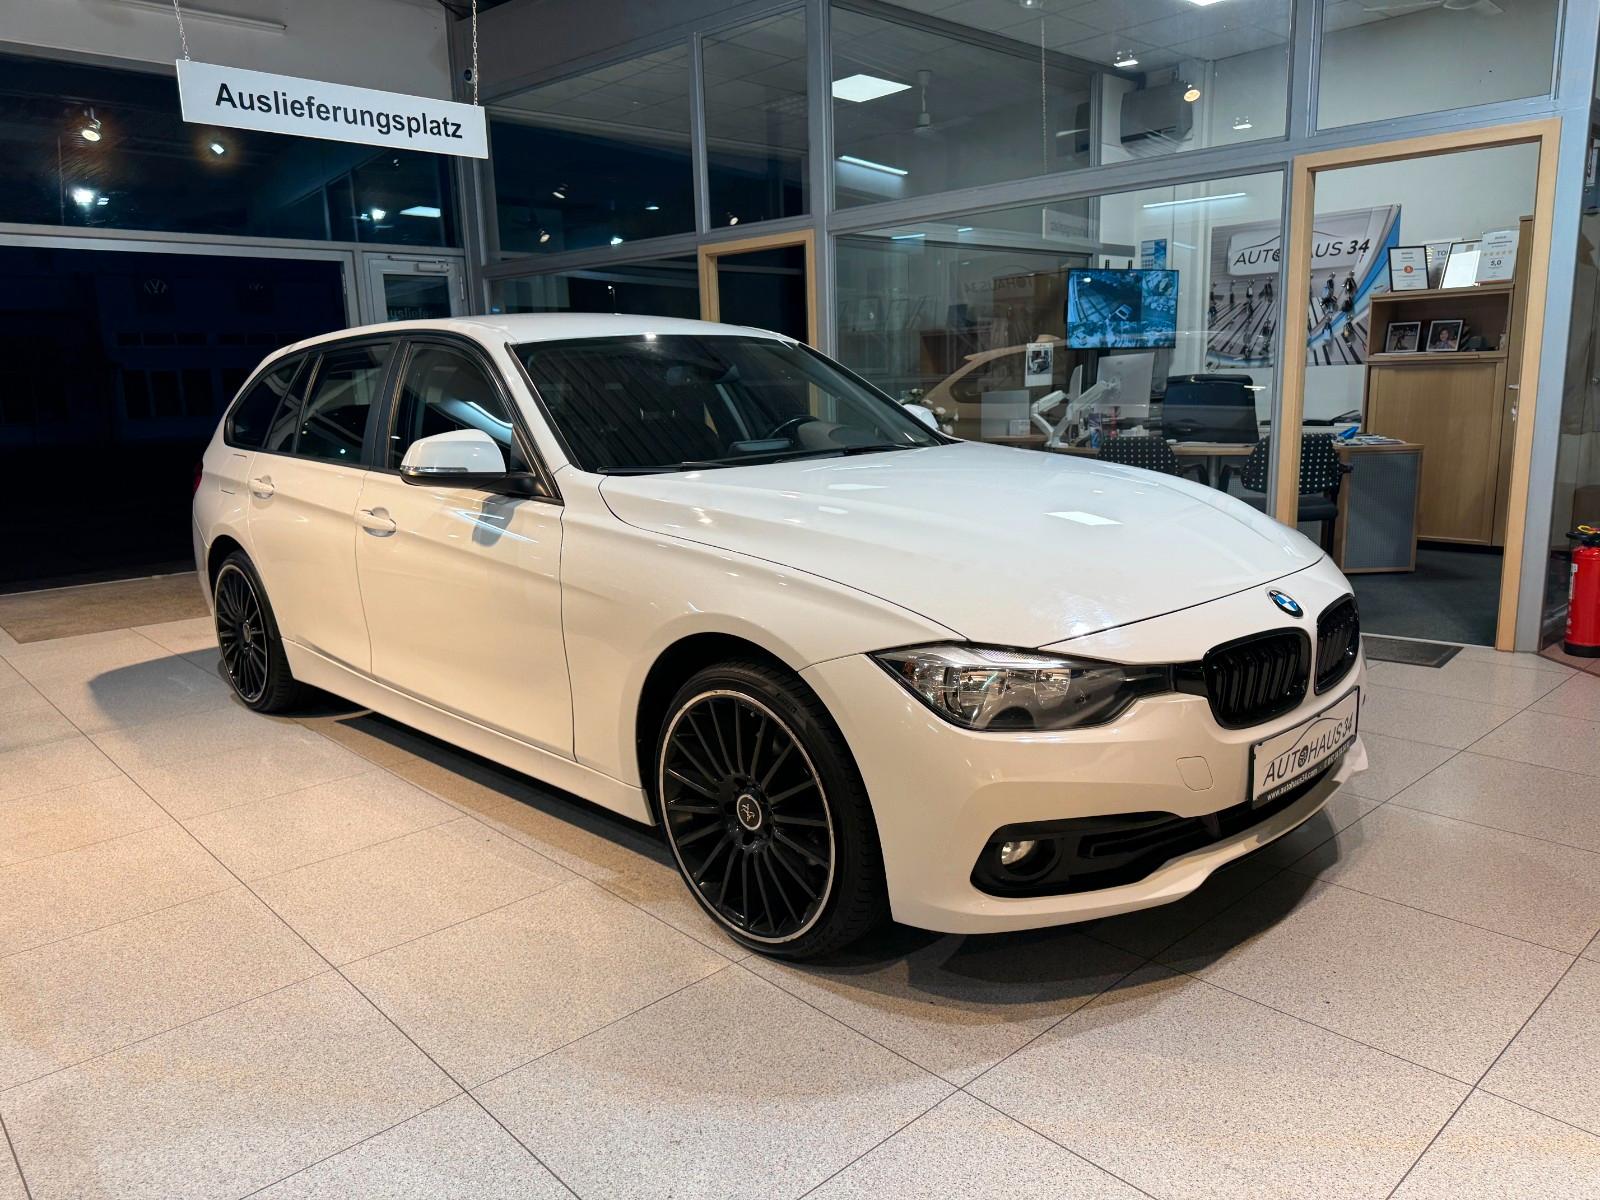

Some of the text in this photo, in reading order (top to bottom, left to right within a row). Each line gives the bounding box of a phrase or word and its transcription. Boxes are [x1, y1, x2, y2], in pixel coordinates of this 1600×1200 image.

[215, 82, 463, 139] Auslieferungsplatz
[1347, 239, 1371, 255] 34
[1263, 721, 1343, 787] AUTOHAUS
[1342, 712, 1354, 738] 34
